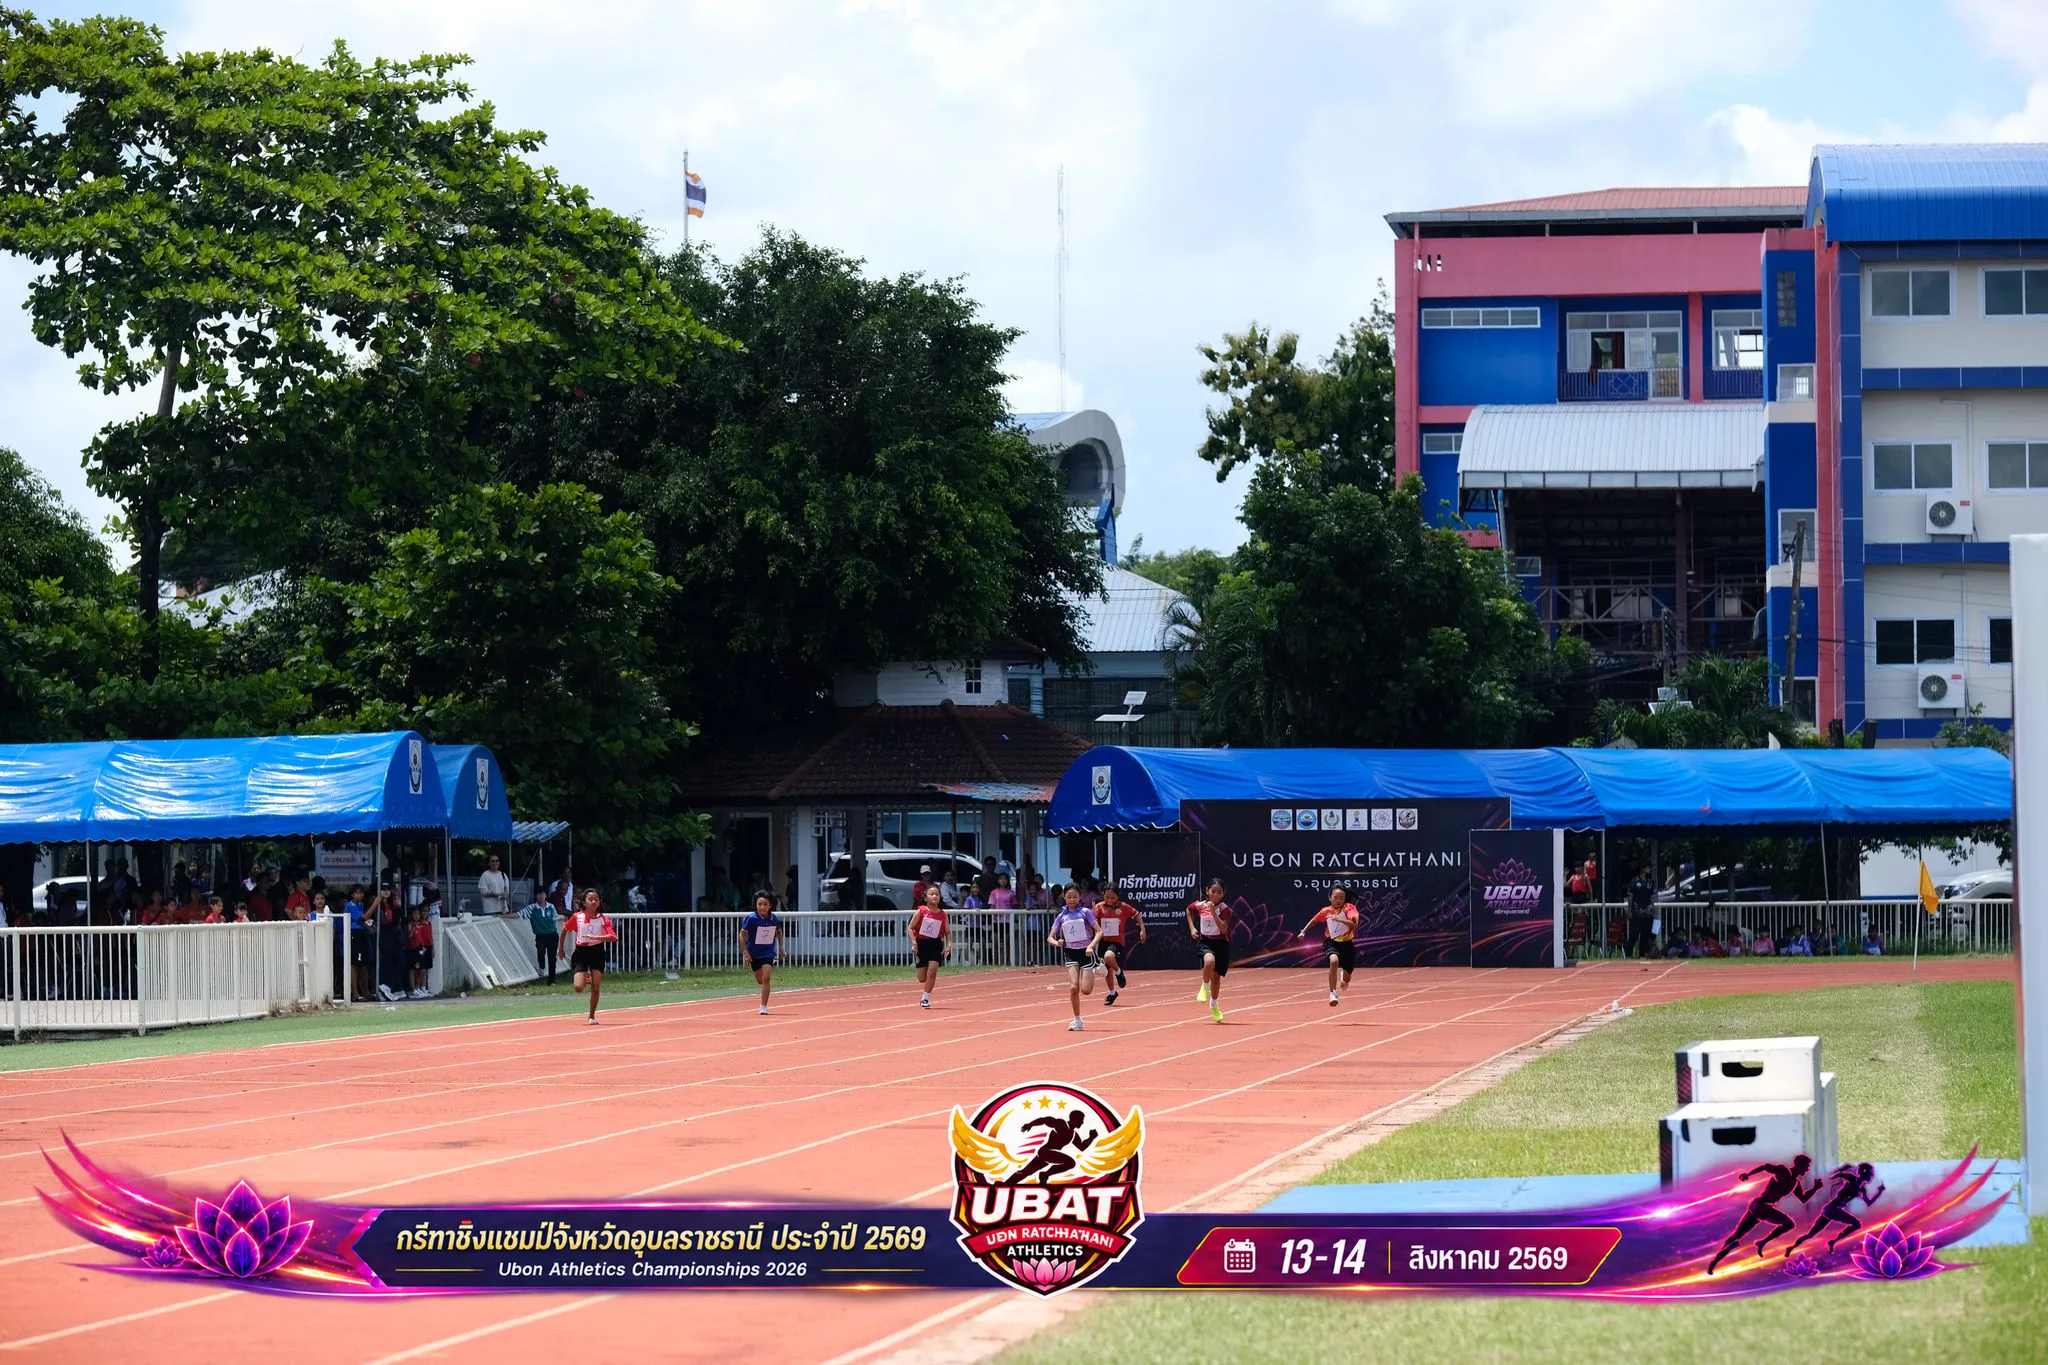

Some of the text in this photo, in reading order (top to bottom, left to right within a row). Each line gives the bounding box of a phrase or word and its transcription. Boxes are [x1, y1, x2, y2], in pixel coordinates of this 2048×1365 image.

[1232, 851, 1462, 868] UBON RATCHATHANI
[1483, 884, 1543, 901] UBON
[1069, 925, 1077, 937] 4
[1104, 921, 1112, 934] 5
